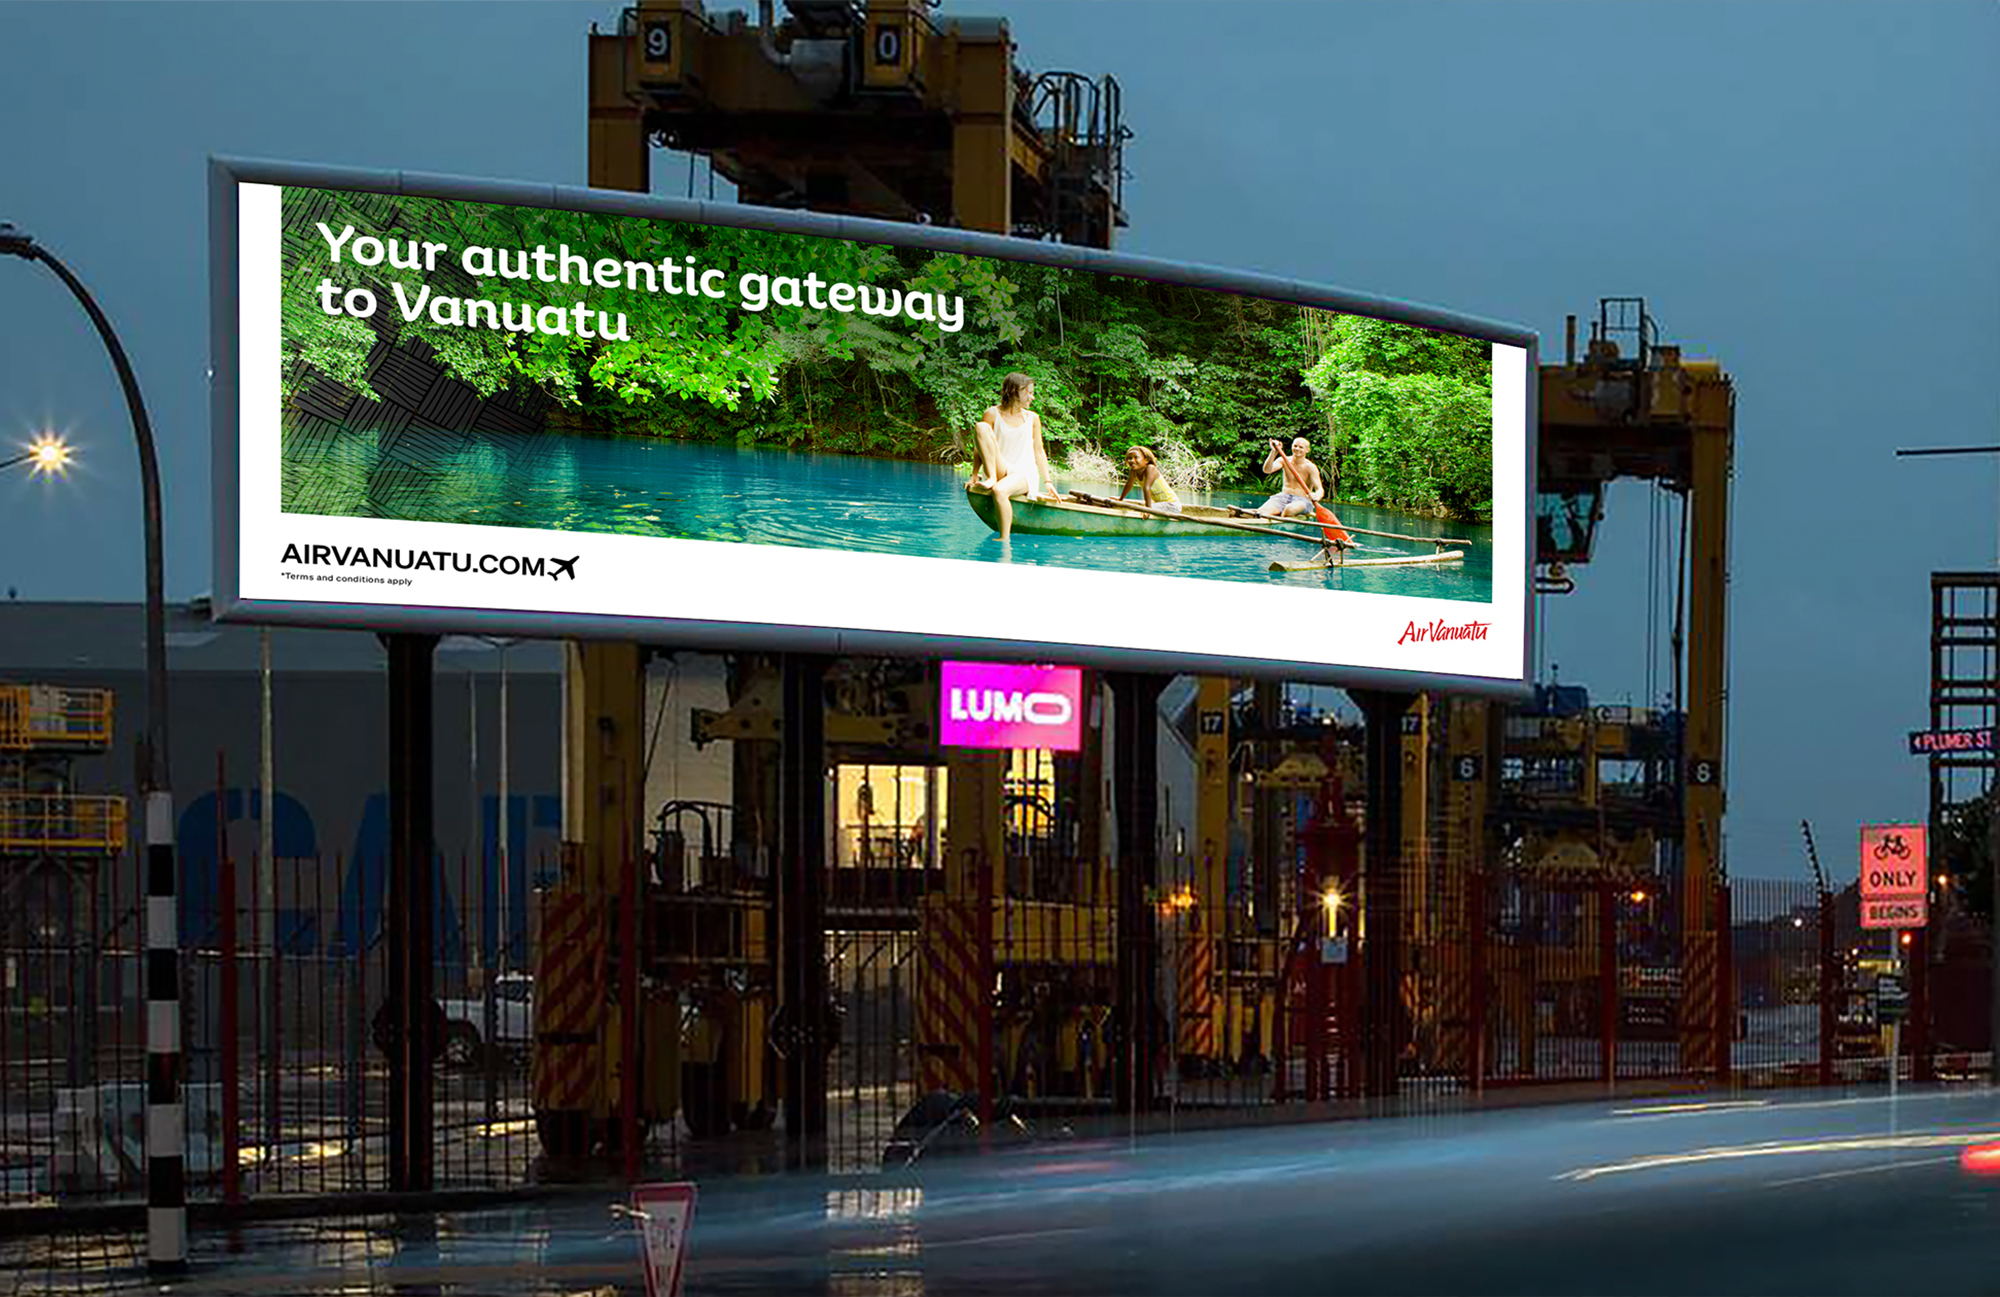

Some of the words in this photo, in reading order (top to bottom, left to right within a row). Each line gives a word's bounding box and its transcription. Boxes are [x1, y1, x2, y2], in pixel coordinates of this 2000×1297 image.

[649, 28, 667, 56] 9
[316, 222, 448, 271] Your
[462, 244, 726, 298] authentic
[739, 269, 964, 332] gateway
[316, 279, 377, 318] to
[391, 282, 632, 342] Vanuatu
[280, 543, 546, 577] AIRVANUATU.COM
[316, 574, 334, 583] and
[335, 576, 385, 585] conditions
[387, 578, 413, 588] apply
[951, 688, 1072, 724] LUMO
[1203, 716, 1221, 732] 17
[1975, 730, 1992, 749] ST
[1869, 870, 1917, 889] ONLY
[1869, 903, 1919, 921] BEGINS
